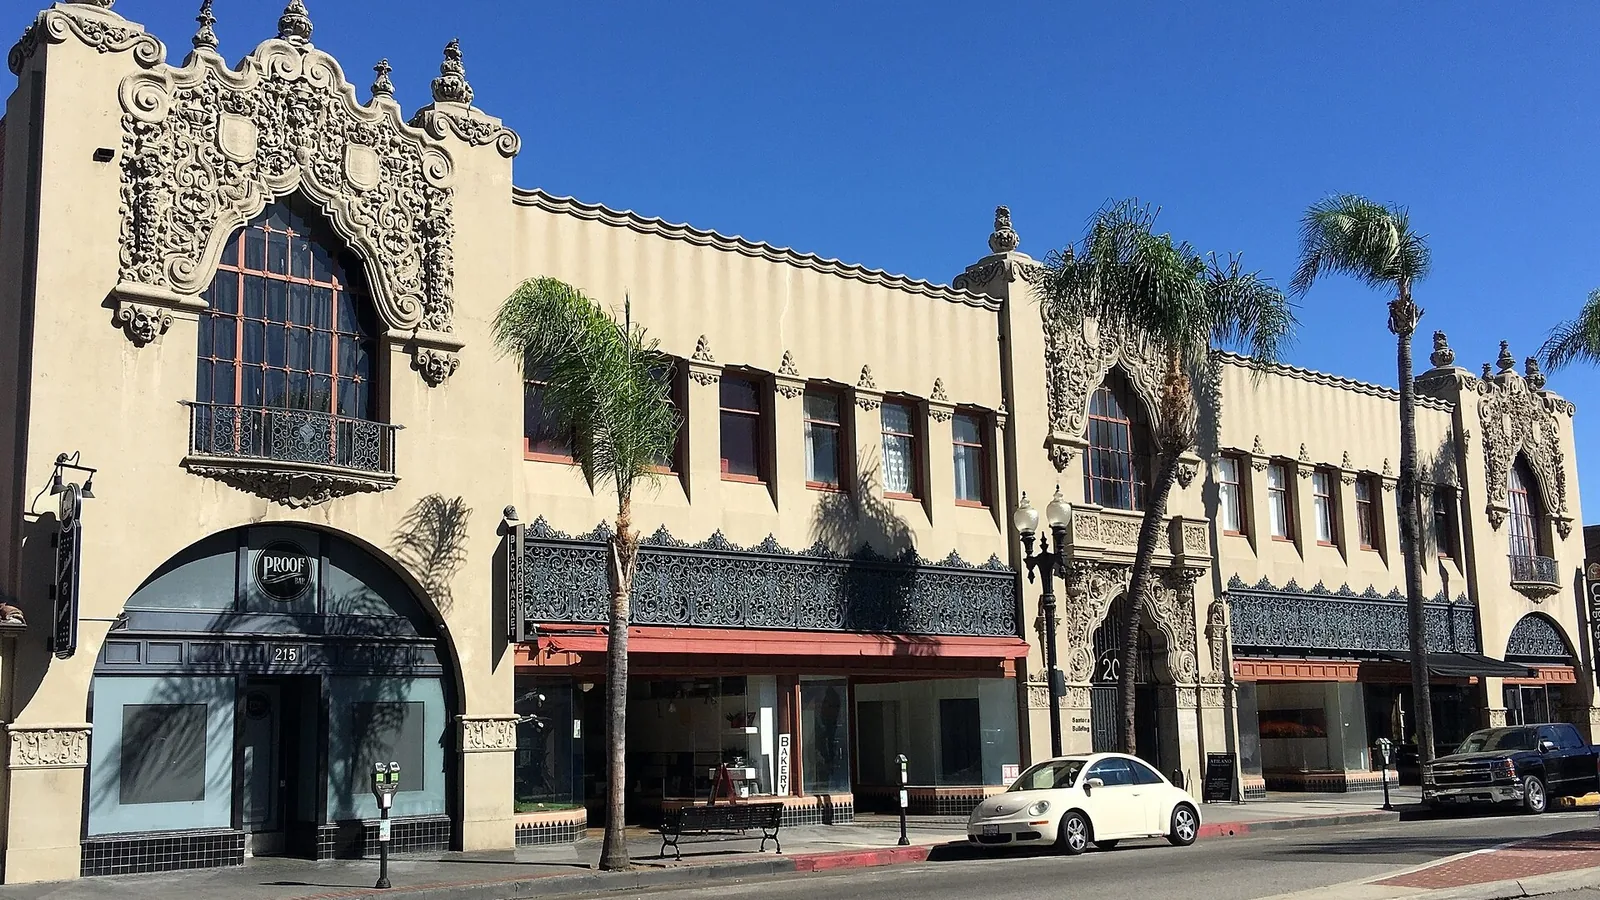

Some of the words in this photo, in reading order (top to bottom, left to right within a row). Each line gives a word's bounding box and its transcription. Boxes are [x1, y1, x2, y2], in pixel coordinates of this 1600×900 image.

[263, 556, 306, 580] PROOF
[275, 647, 297, 661] 215
[1071, 725, 1090, 734] Building
[780, 736, 789, 793] BAKERY
